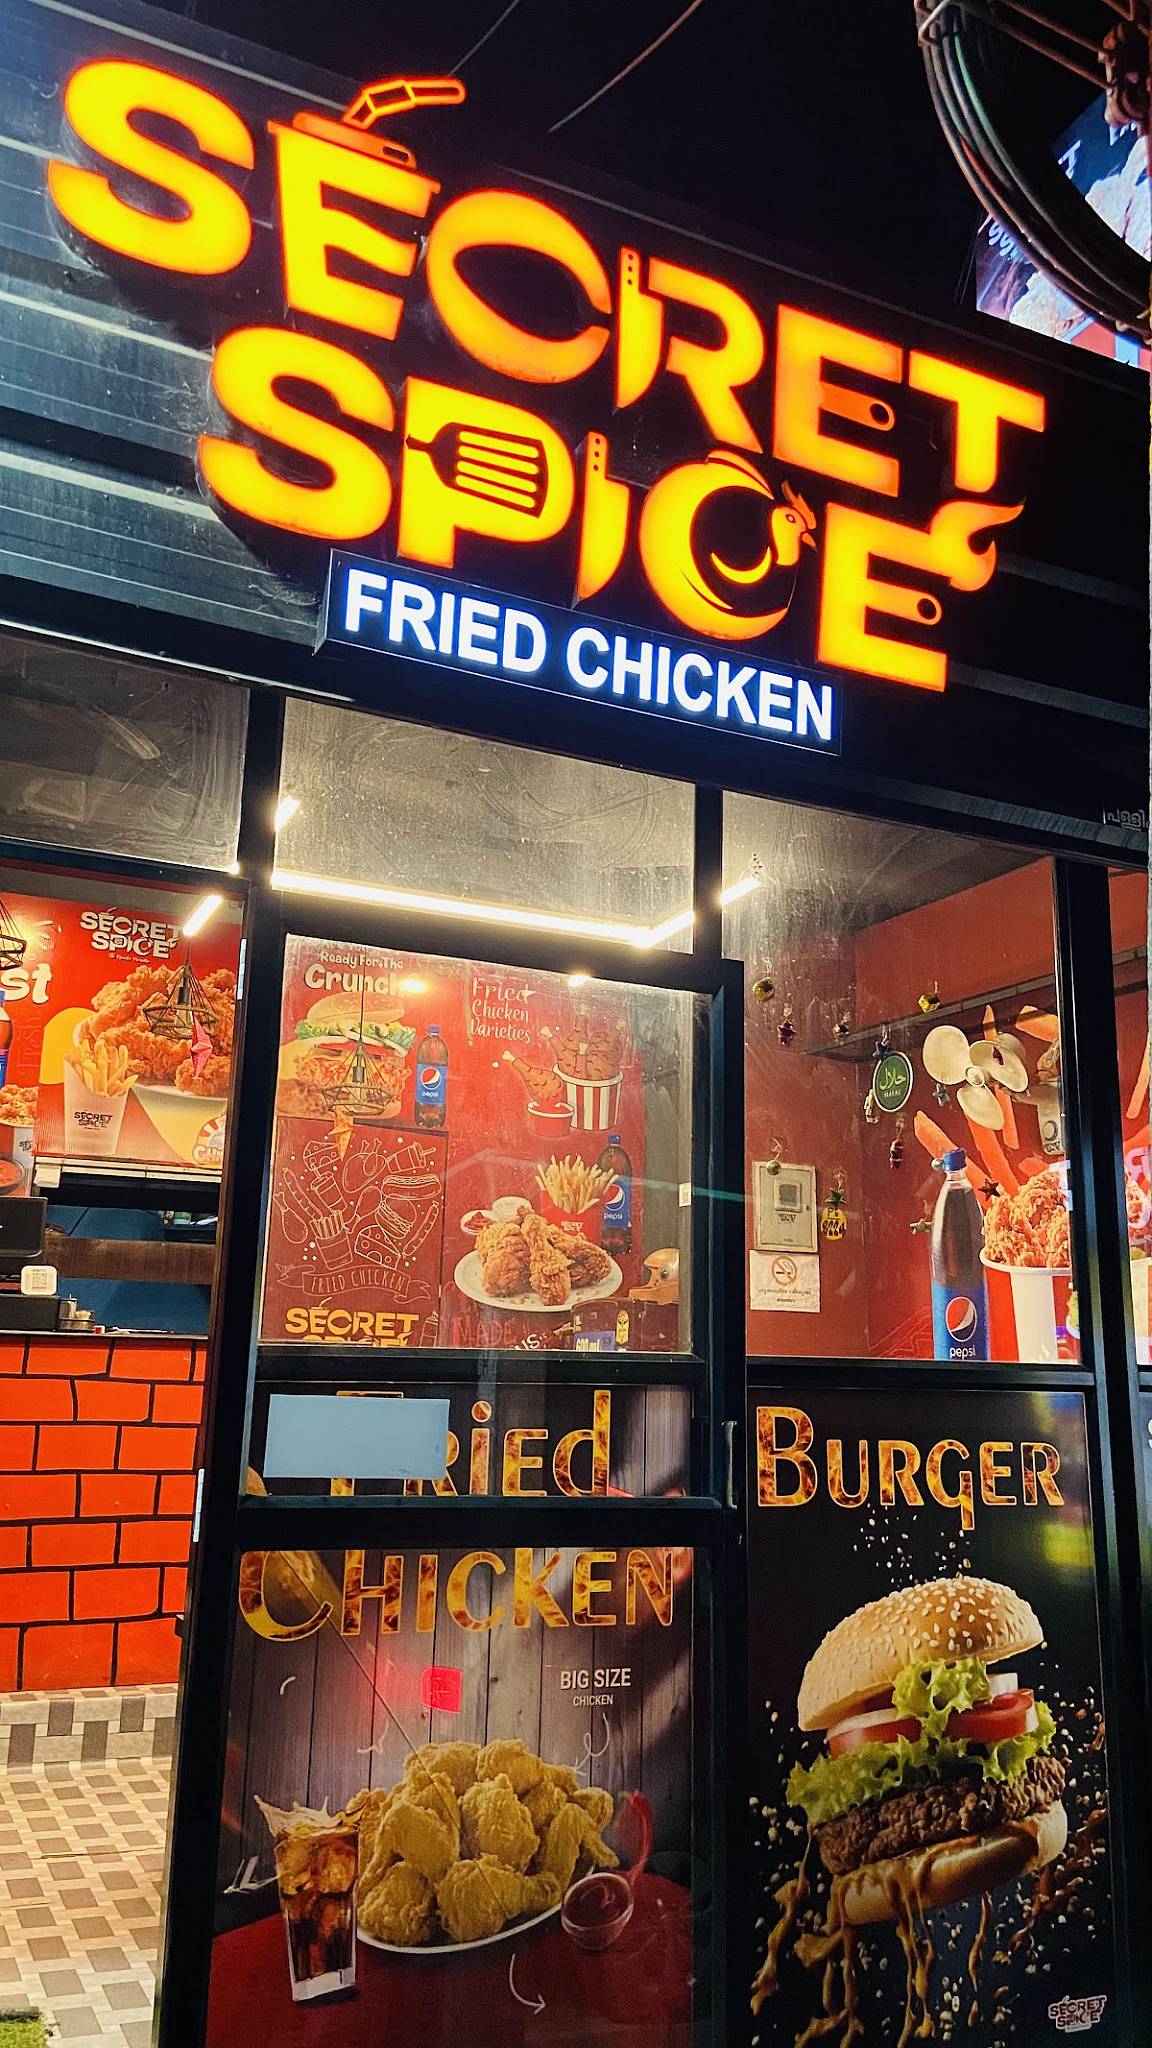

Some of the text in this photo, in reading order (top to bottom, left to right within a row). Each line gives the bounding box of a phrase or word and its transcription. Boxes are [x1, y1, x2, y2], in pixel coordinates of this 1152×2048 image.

[47, 60, 1046, 497] SECRET
[199, 327, 1024, 692] SPICE
[344, 568, 833, 741] FRIED CHICKEN
[79, 907, 182, 941] SECRET
[91, 930, 181, 959] SPICE
[320, 951, 358, 968] Ready
[359, 955, 378, 967] For
[472, 999, 529, 1023] Chicken
[471, 1017, 531, 1044] Varieties
[311, 1268, 406, 1294] FRIED CHICKEN
[285, 1297, 419, 1336] SECRET
[950, 1345, 976, 1359] pepsi
[239, 1548, 674, 1641] CHICKEN
[560, 1667, 632, 1690] BIG SIZE
[573, 1694, 614, 1707] CHICKEN
[1048, 1995, 1106, 2017] SECRET
